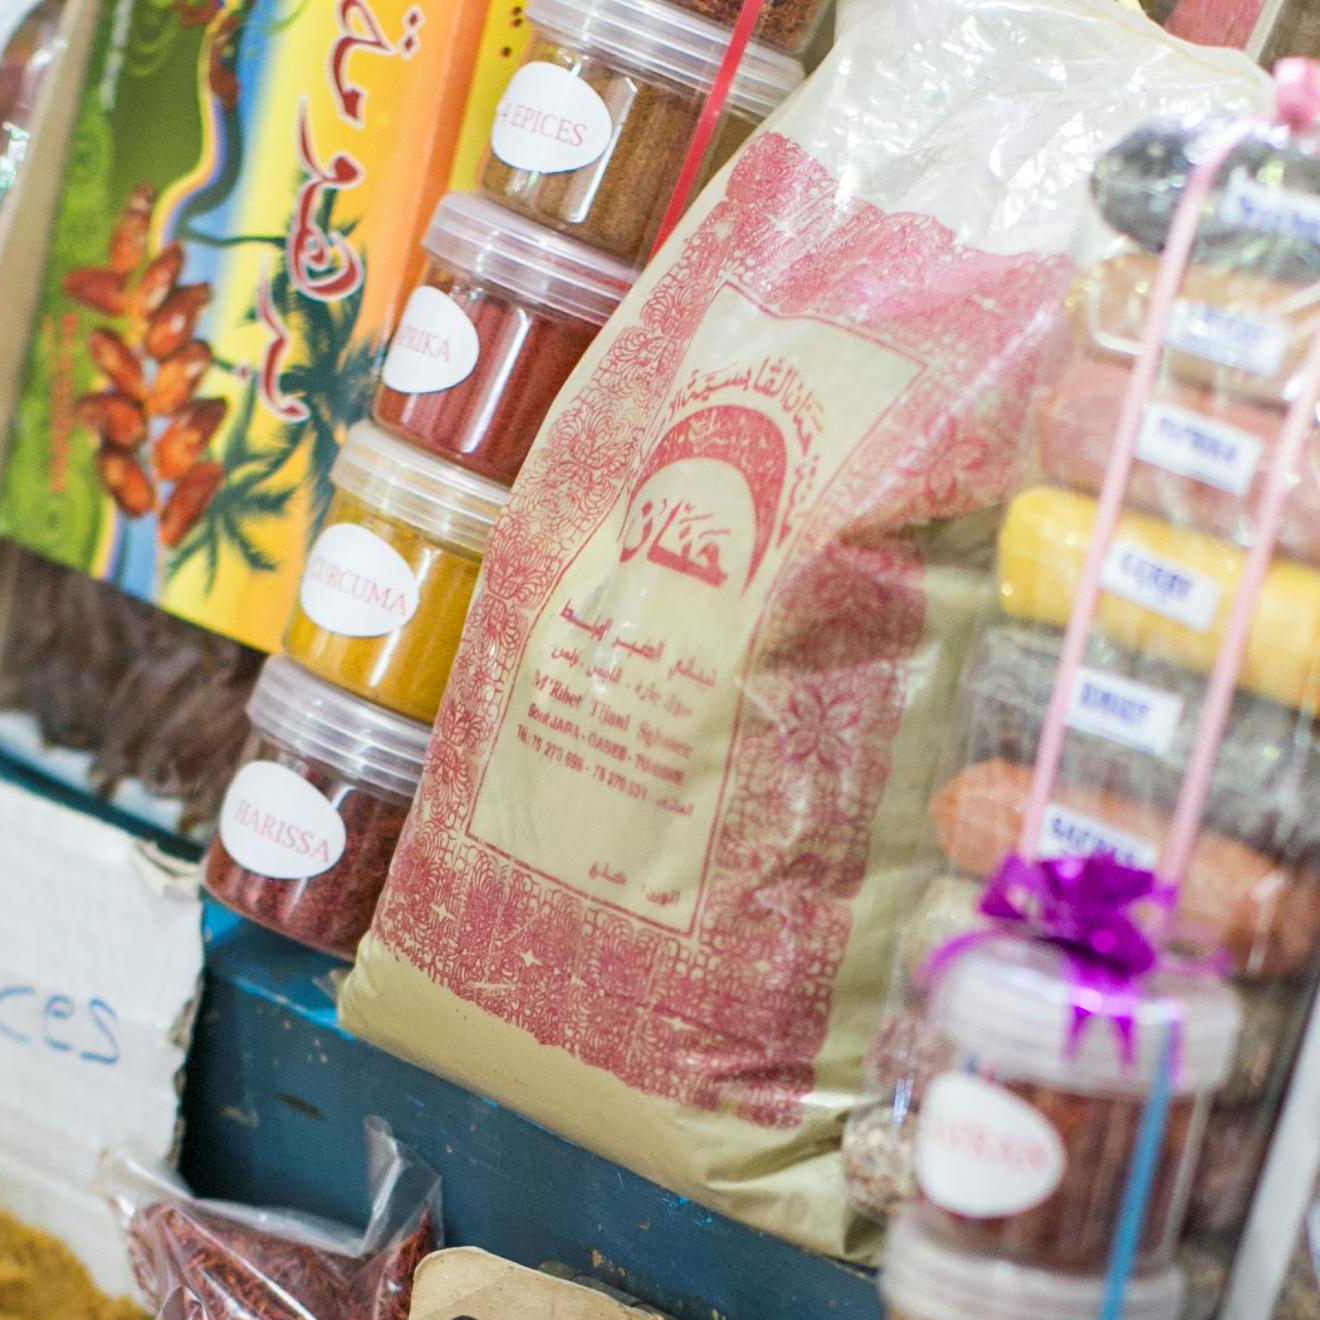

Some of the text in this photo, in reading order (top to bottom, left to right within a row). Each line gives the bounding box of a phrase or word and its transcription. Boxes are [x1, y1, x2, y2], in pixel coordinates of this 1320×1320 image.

[510, 103, 588, 147] EPICES
[309, 554, 408, 617] CURCUMA
[233, 799, 330, 863] HARISSA
